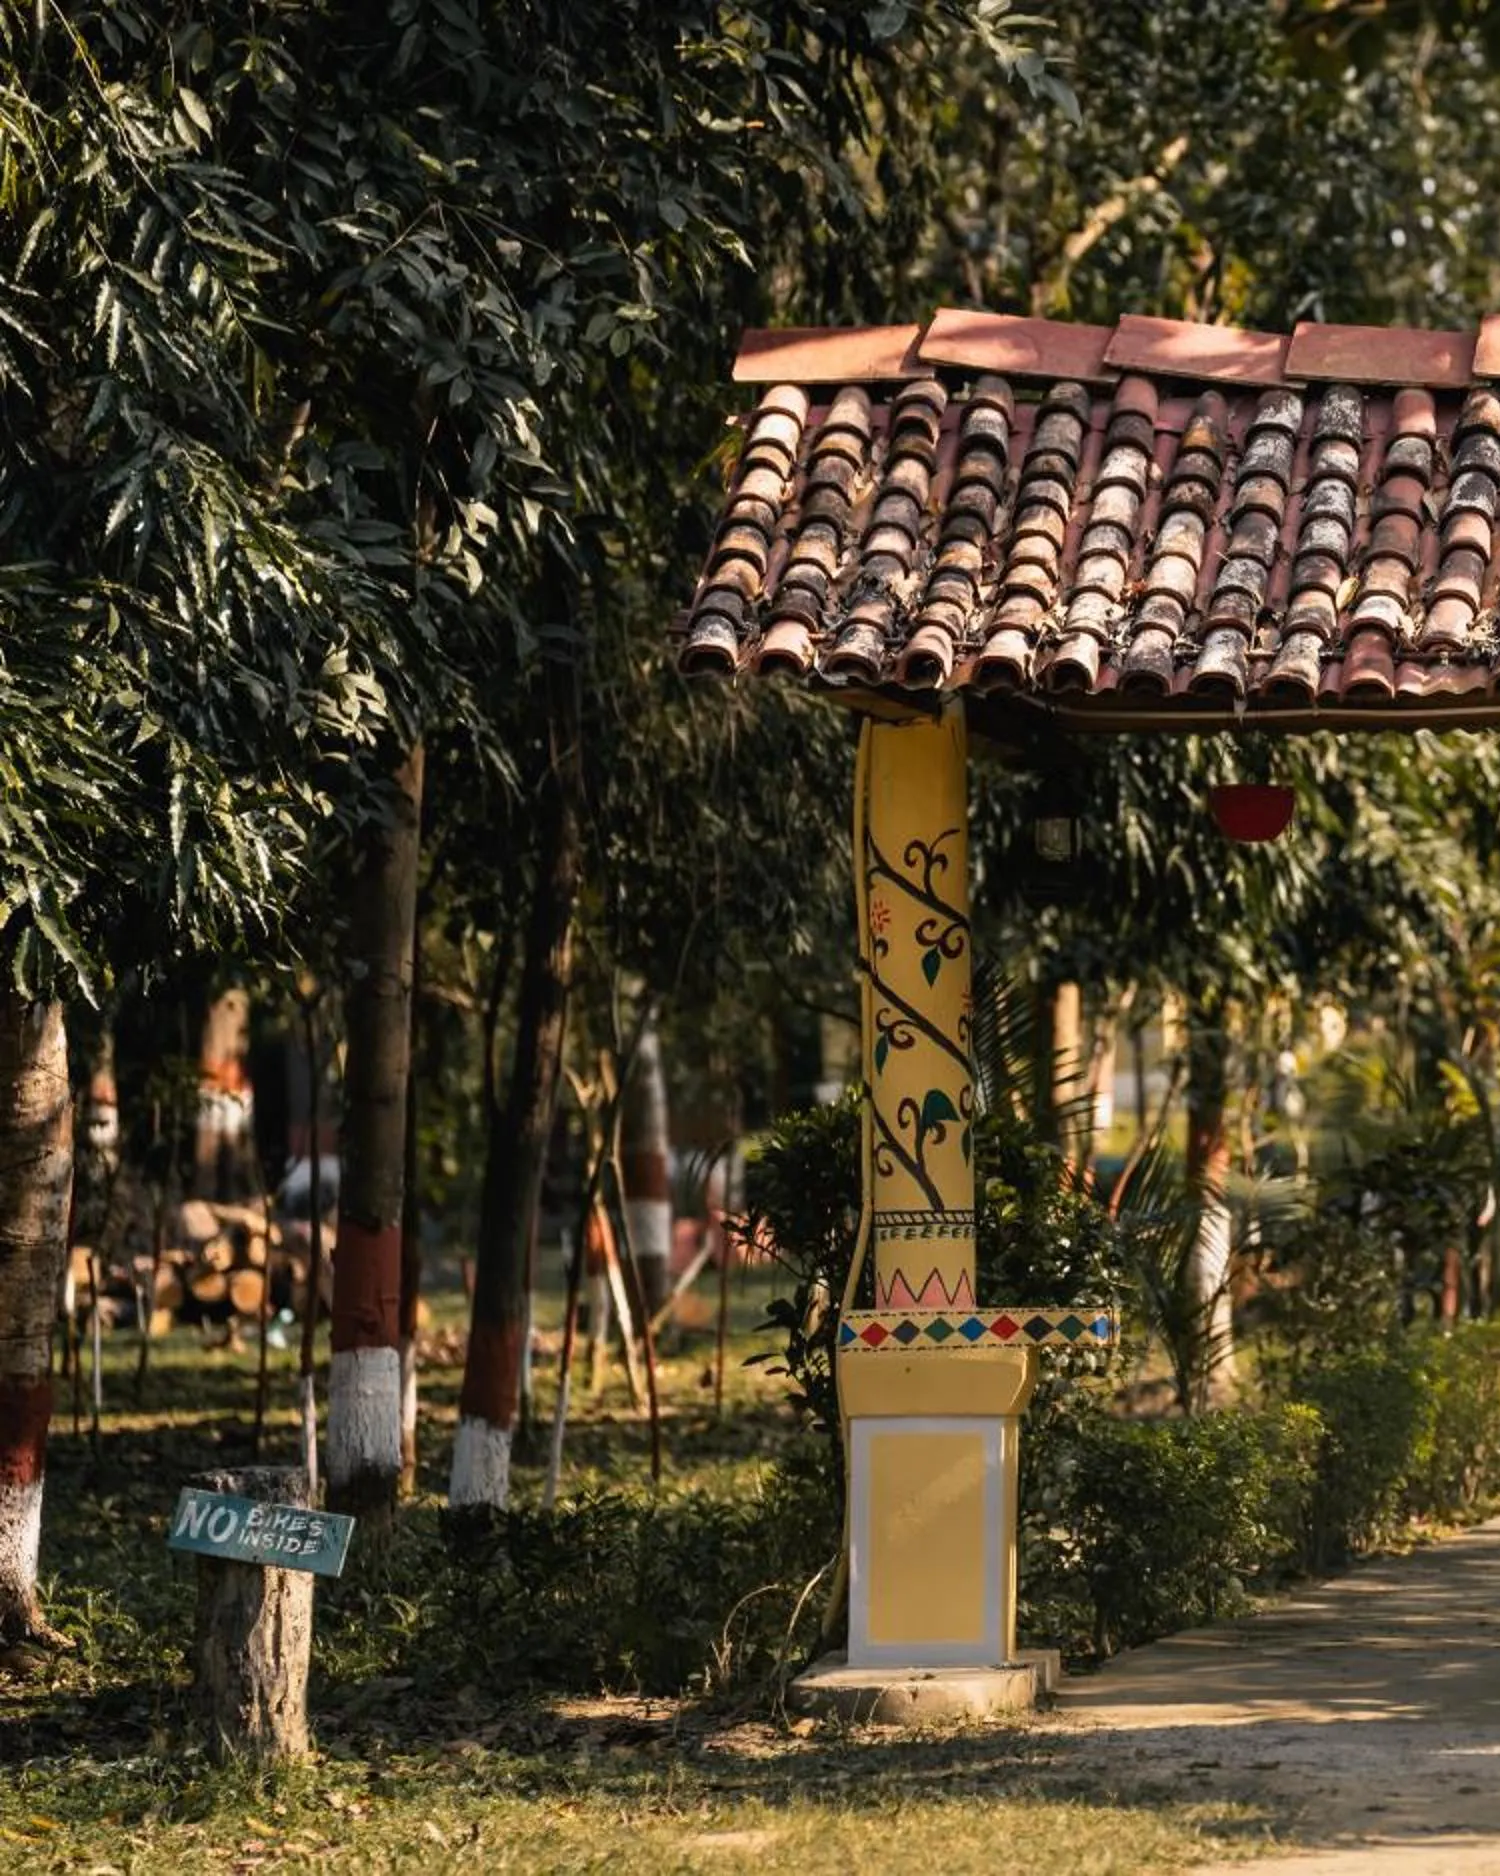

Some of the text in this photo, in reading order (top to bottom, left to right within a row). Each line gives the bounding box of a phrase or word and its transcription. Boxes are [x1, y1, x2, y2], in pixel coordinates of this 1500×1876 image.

[175, 1500, 324, 1543] NO BIKES
[237, 1529, 318, 1555] INSIDE
